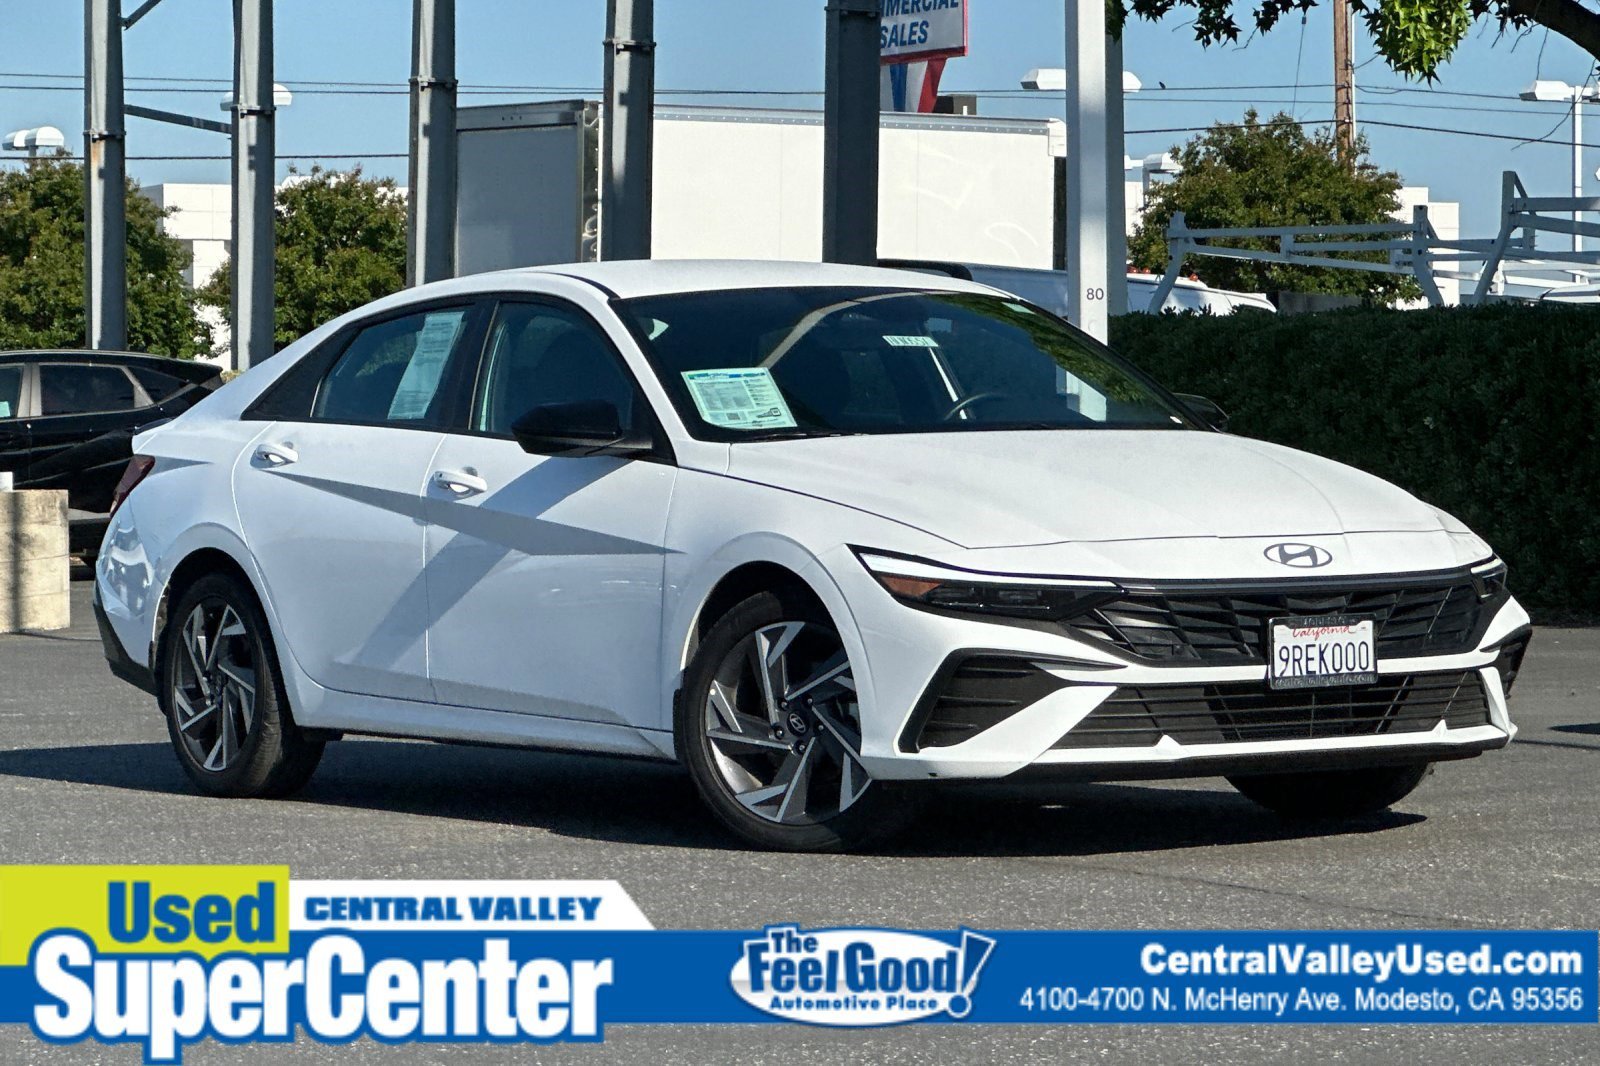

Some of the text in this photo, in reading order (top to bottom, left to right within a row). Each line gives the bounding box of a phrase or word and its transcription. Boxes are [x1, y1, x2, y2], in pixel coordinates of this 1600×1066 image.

[880, 20, 929, 49] SALES
[1087, 287, 1104, 301] 80
[1292, 625, 1355, 641] California
[1279, 641, 1369, 676] 9REK000
